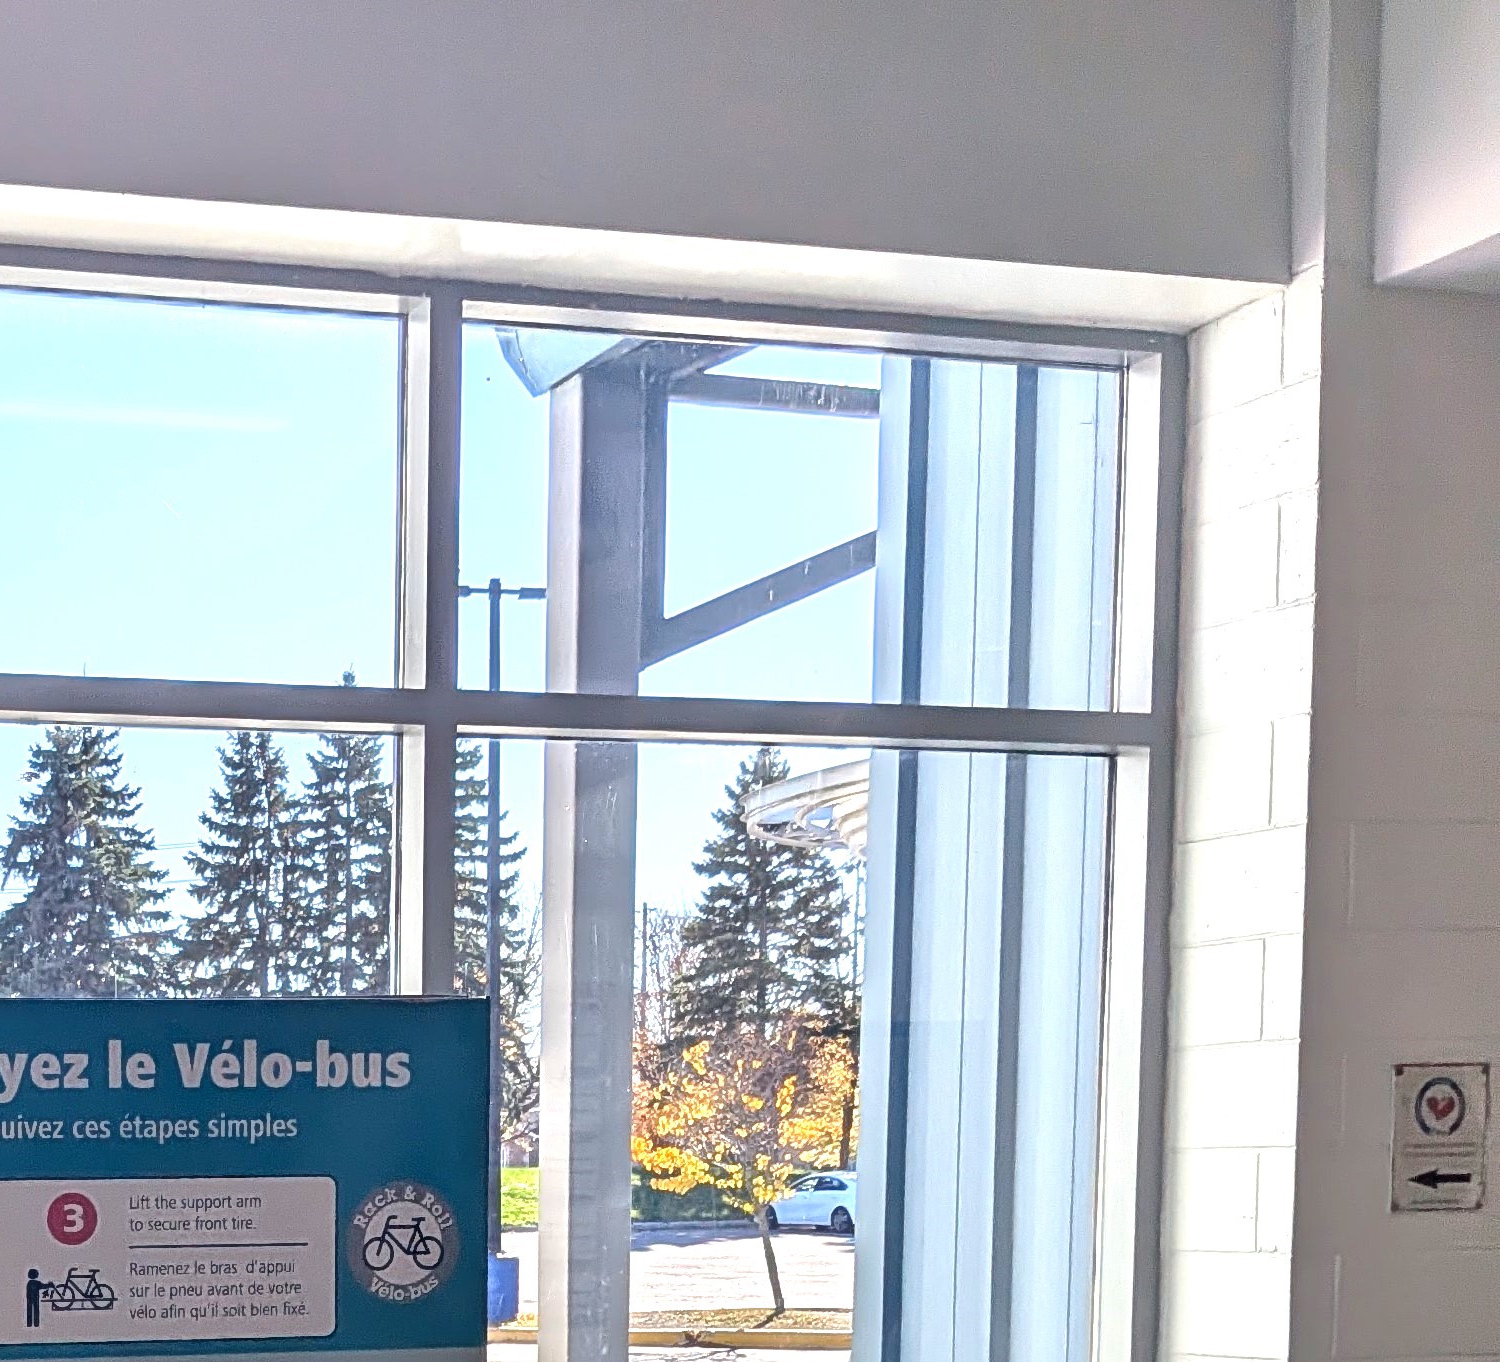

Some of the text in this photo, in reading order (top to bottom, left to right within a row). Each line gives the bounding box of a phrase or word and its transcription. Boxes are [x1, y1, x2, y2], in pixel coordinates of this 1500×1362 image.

[108, 1040, 156, 1088] le
[173, 1039, 412, 1089] Vélo-bus
[73, 1118, 110, 1140] ces
[119, 1113, 199, 1145] étapes
[208, 1112, 298, 1143] simples
[129, 1195, 262, 1212] Lift the support arm
[353, 1185, 453, 1230] Rack & Roll
[62, 1204, 85, 1233] 3
[130, 1216, 257, 1231] to secure front tire.
[129, 1259, 295, 1276] Ramenez le bras d'appui
[130, 1281, 302, 1299] sur le pneu avant de votre
[130, 1301, 309, 1321] vélo afin qu'il soit bien fixé.
